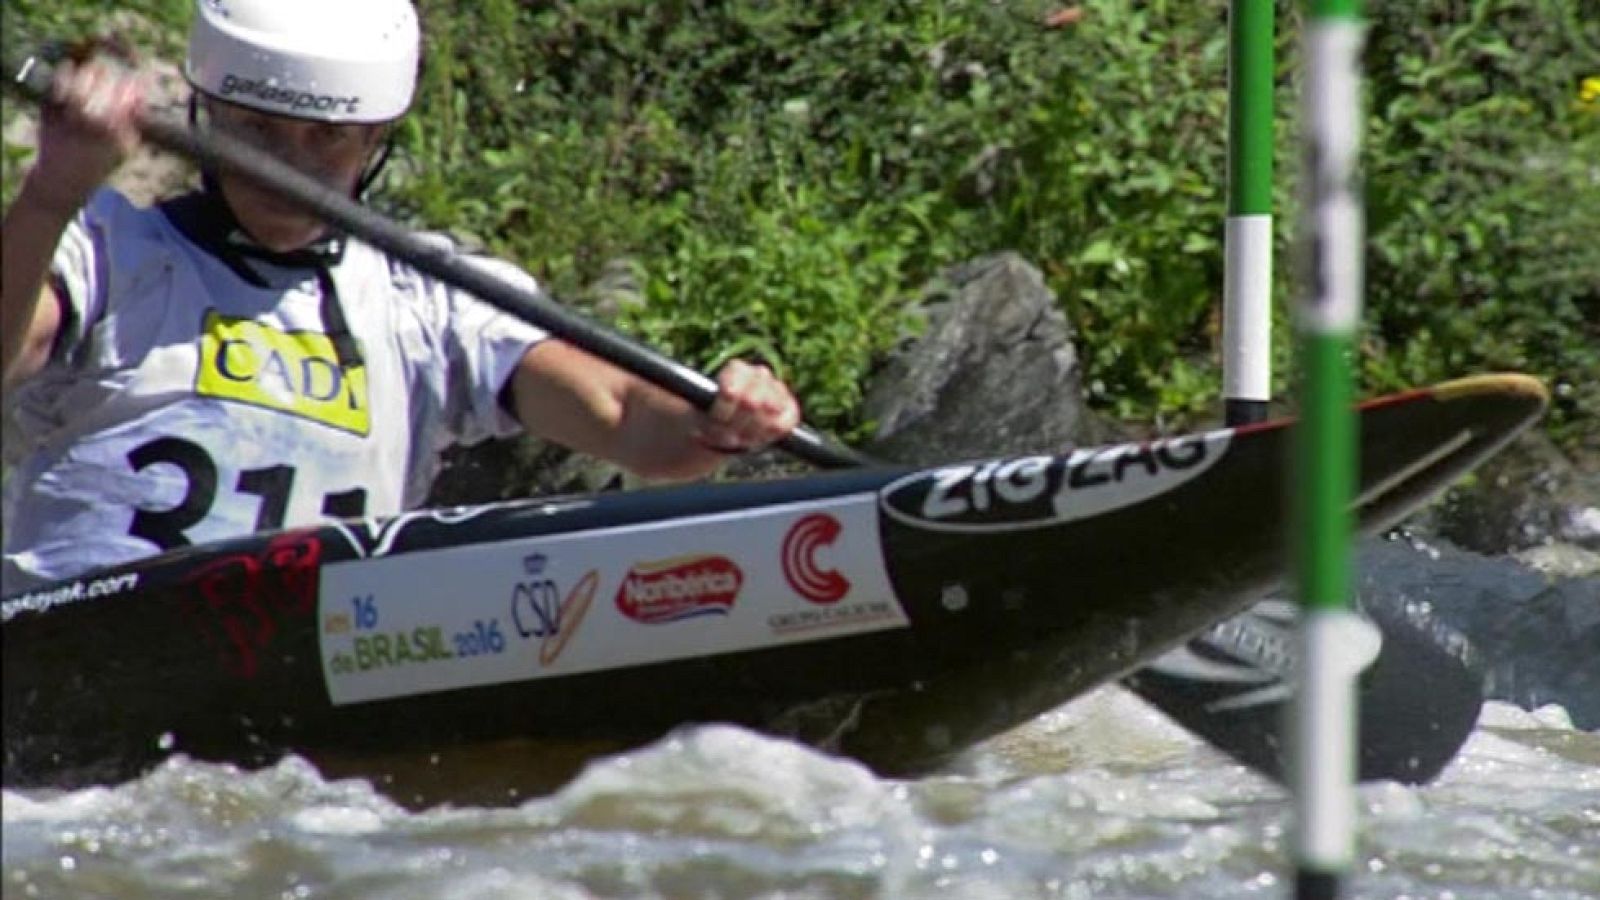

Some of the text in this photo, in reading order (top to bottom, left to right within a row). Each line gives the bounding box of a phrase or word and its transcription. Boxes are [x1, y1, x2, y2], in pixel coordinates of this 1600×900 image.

[220, 73, 360, 114] galasport
[922, 436, 1207, 519] ZIG ZAG
[352, 594, 378, 629] 16
[354, 626, 451, 671] BRASIL
[453, 618, 507, 659] 2016
